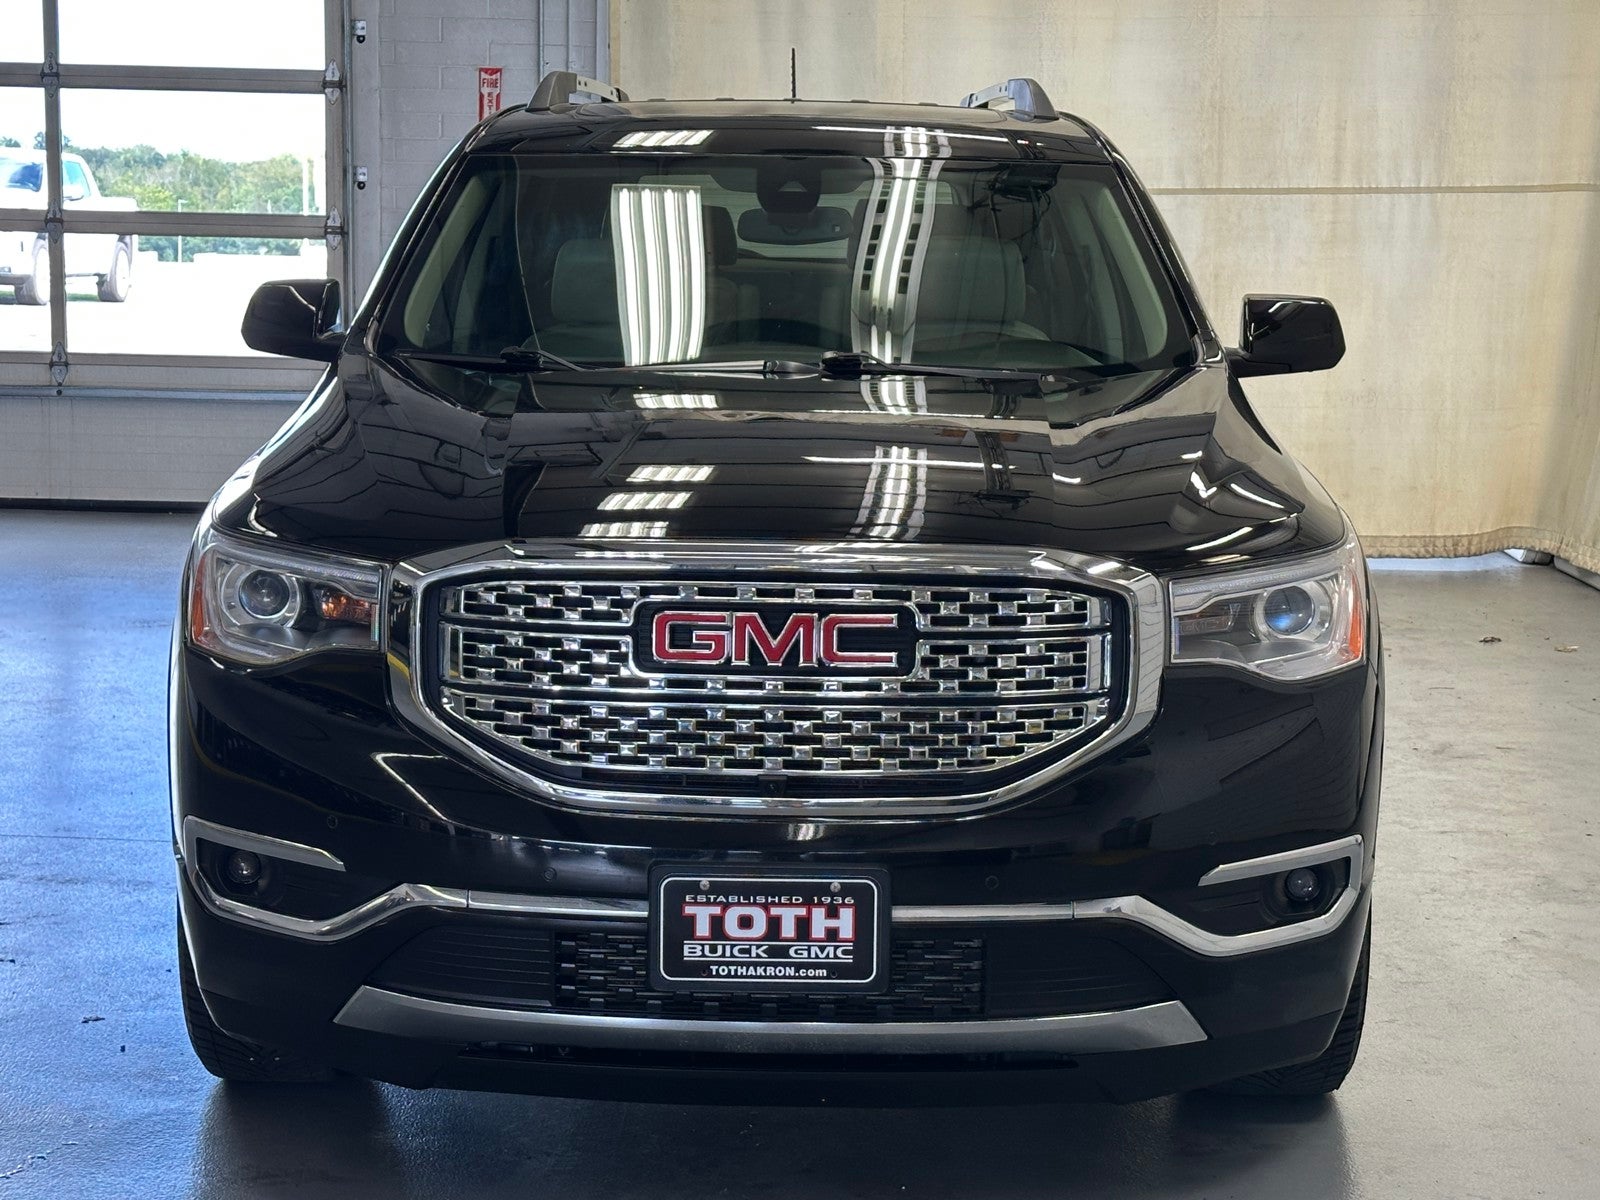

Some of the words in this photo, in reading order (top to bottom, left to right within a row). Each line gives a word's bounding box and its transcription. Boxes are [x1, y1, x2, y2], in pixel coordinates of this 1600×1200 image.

[482, 78, 498, 88] FIRE
[652, 611, 898, 667] GMC
[685, 894, 803, 904] ESTABLISHED
[813, 896, 855, 904] 1936
[682, 903, 856, 941] TOTH
[684, 944, 768, 958] BUICK
[789, 945, 853, 958] GMC
[710, 965, 827, 977] TOTHAKRON.com
